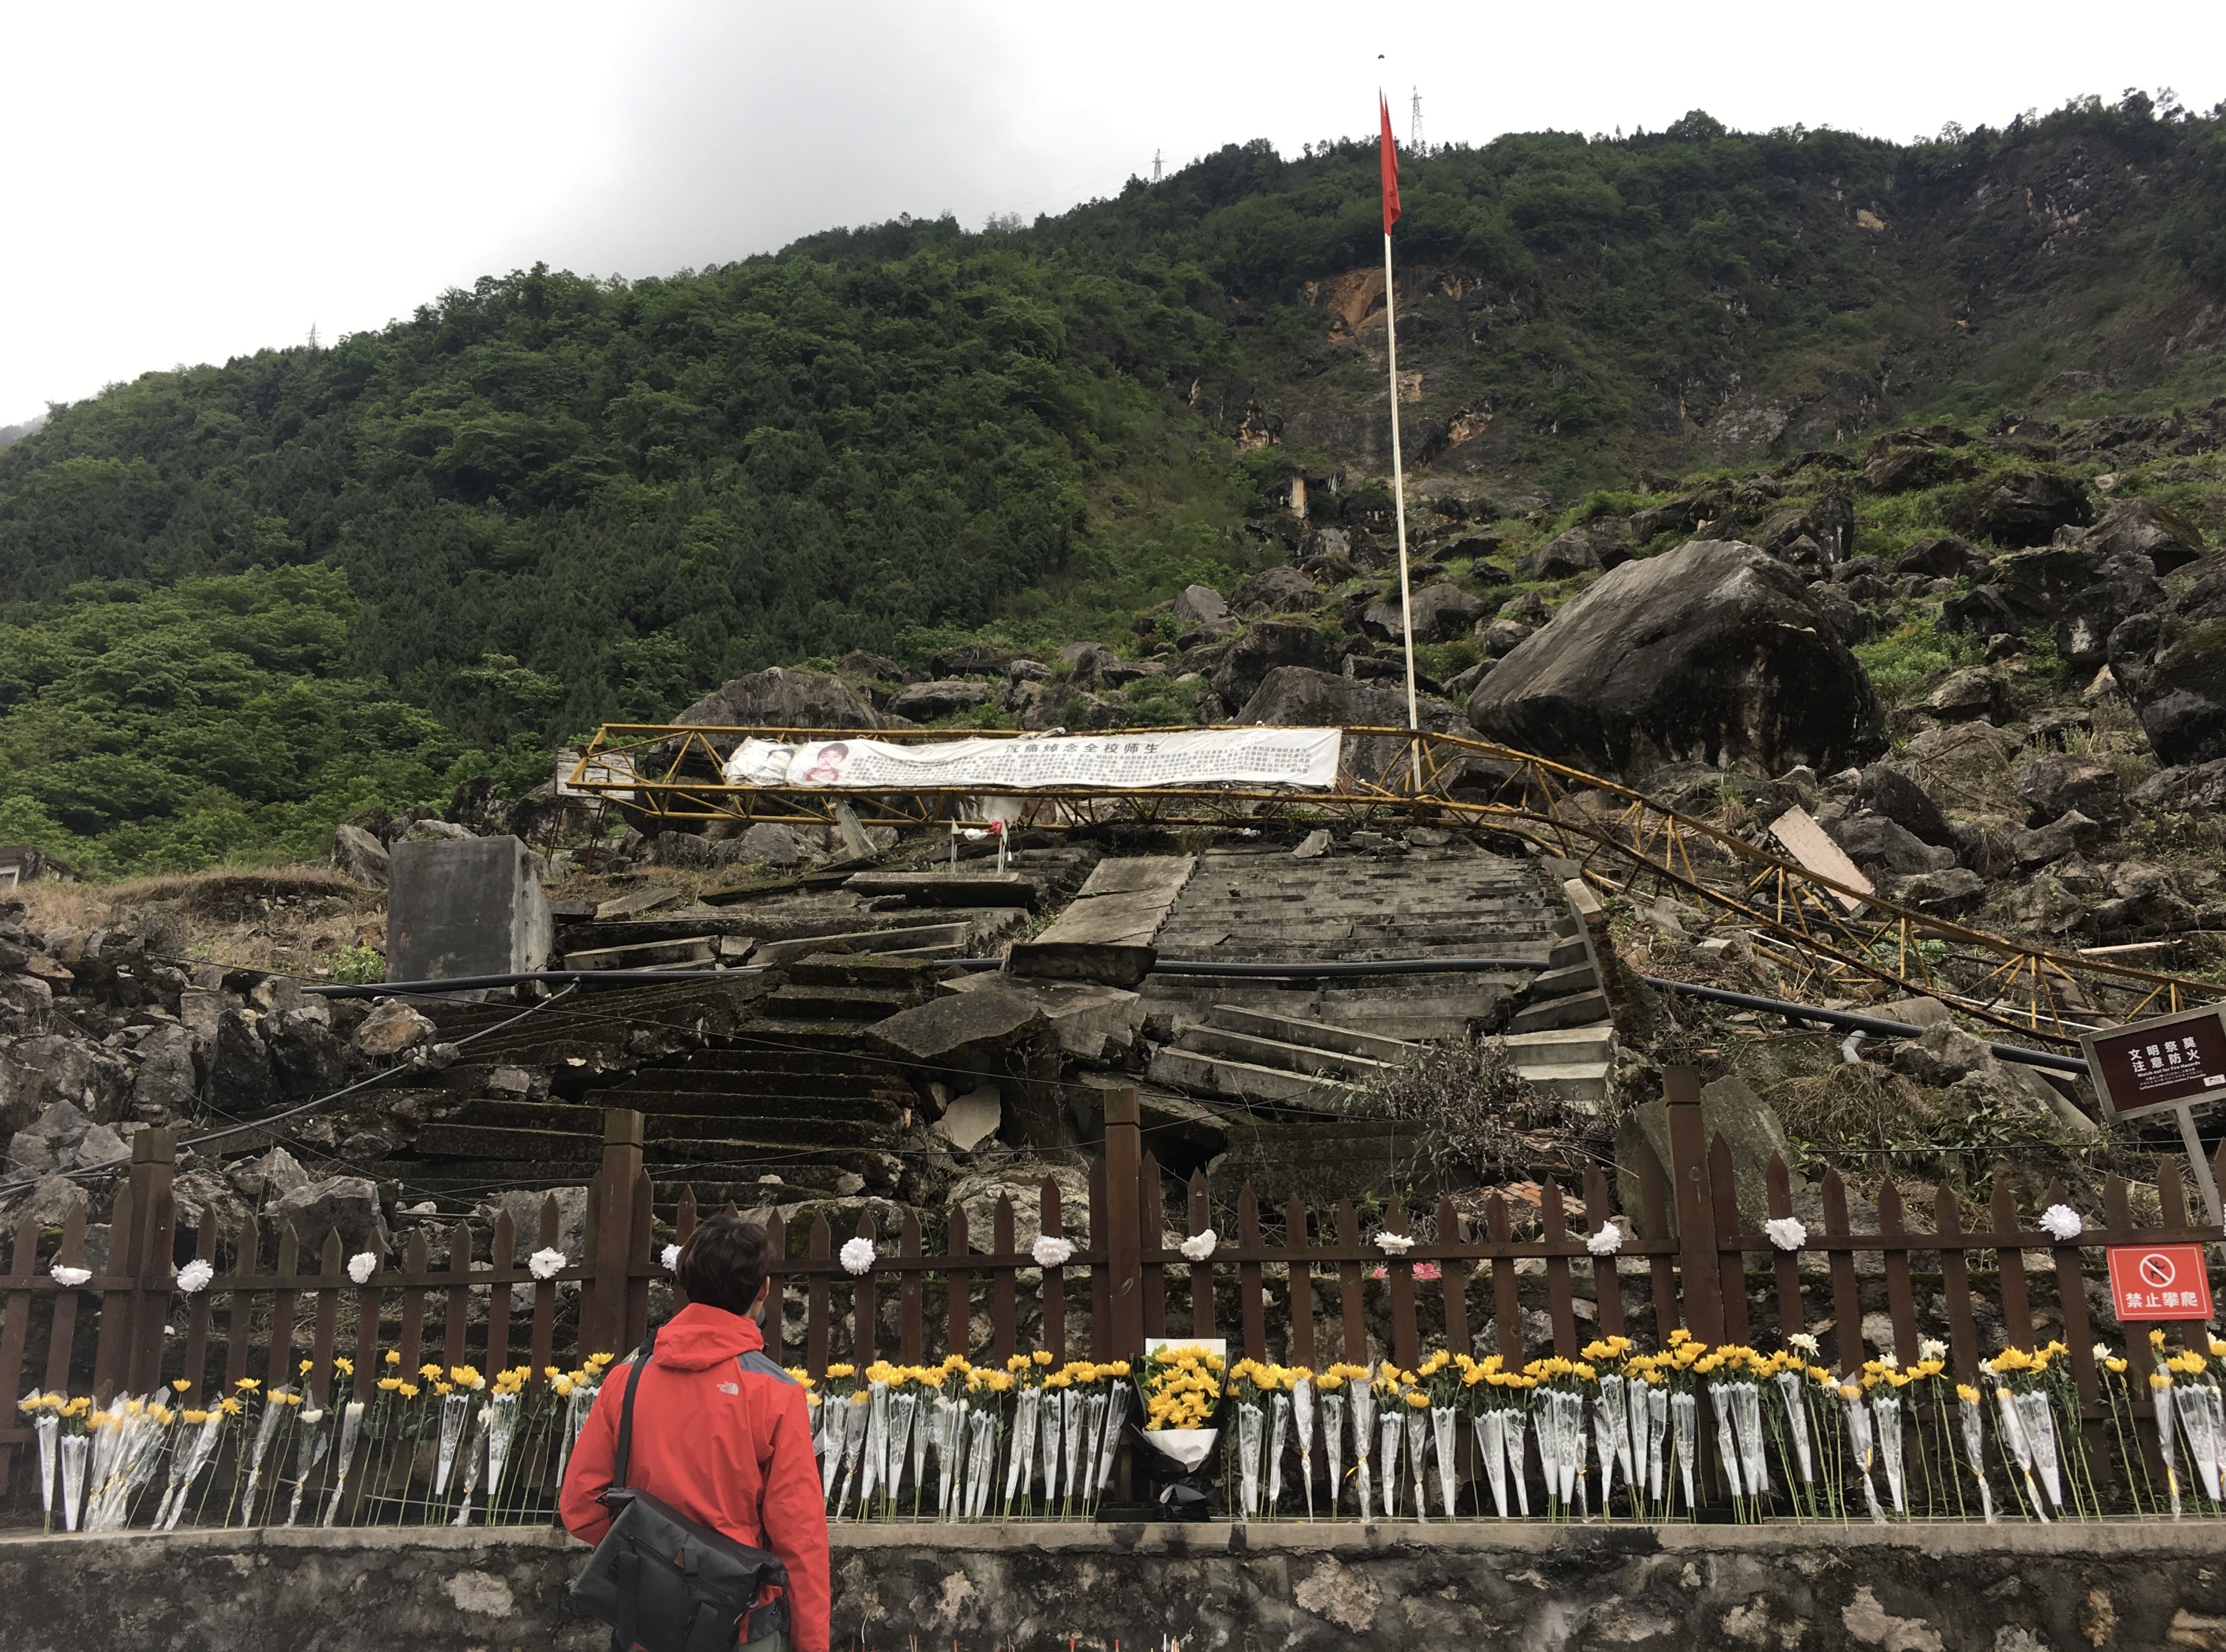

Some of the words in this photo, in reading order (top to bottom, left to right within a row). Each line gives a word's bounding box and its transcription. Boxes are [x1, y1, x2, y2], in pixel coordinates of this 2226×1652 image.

[2128, 1036, 2197, 1060] 文明祭奠
[2132, 1049, 2200, 1072] 注意防火
[2125, 1291, 2198, 1308] 禁止攀爬
